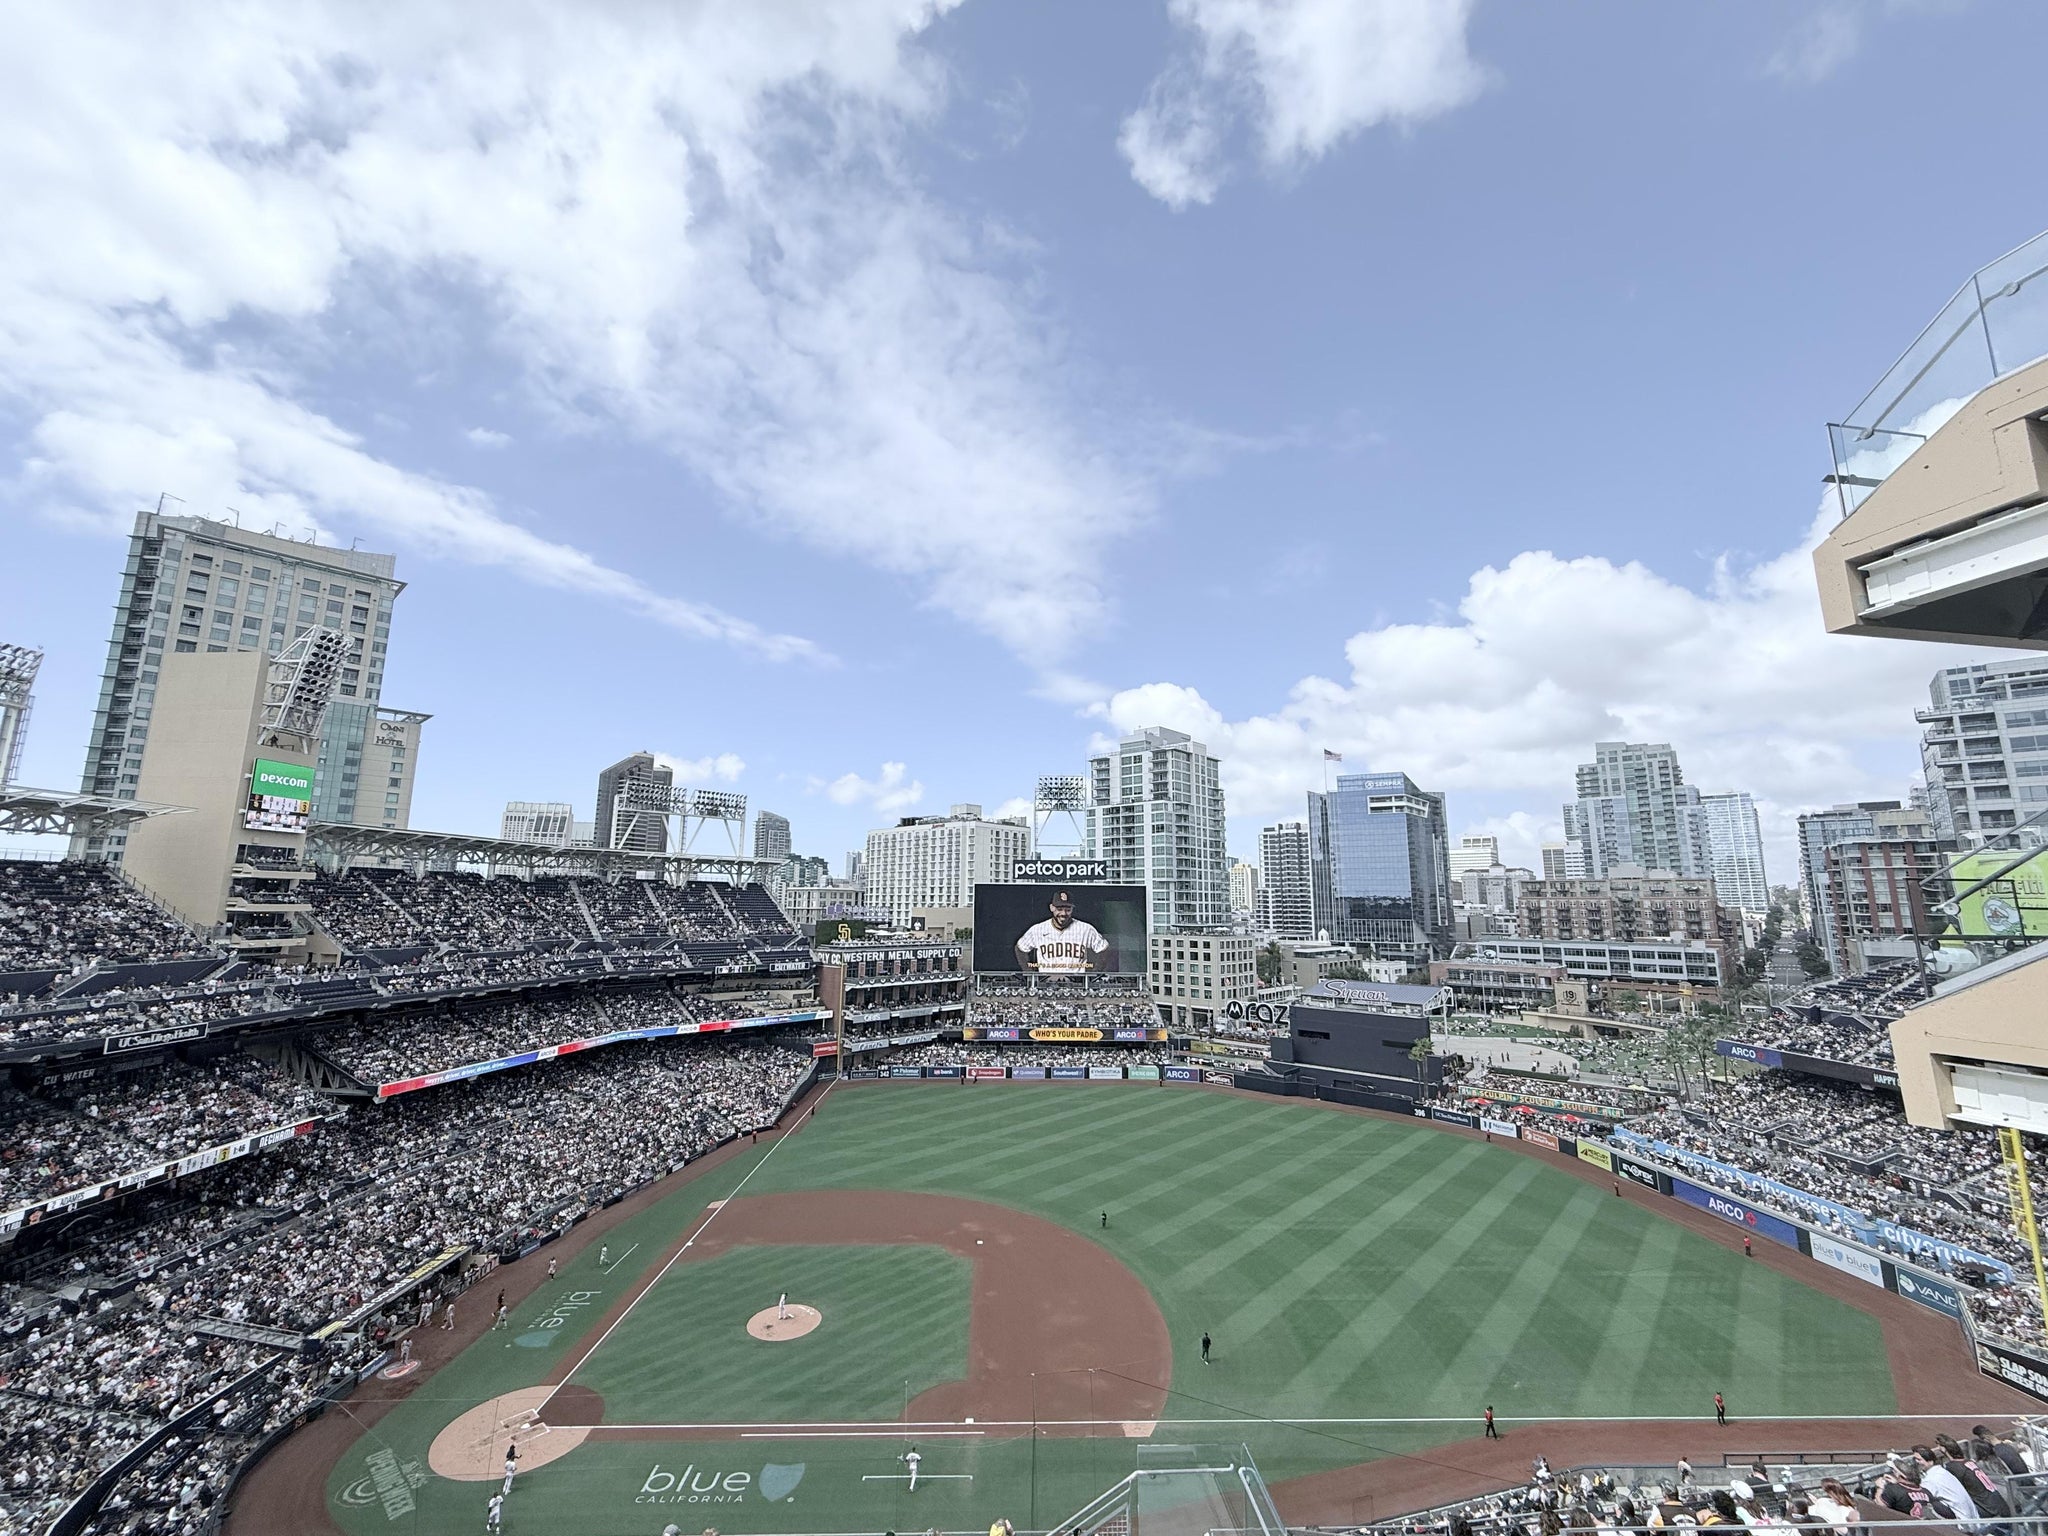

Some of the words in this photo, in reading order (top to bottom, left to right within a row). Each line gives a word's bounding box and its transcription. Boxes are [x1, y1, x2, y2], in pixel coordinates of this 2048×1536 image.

[1014, 861, 1064, 879] petco
[1066, 862, 1105, 879] park
[843, 951, 885, 963] WESTERN
[888, 950, 915, 961] METAL
[917, 949, 946, 959] SUPPLY
[949, 948, 962, 957] CO.
[1039, 942, 1086, 959] PADRES
[1324, 979, 1388, 1003] Sycuan
[1034, 1030, 1057, 1038] WHO'S
[1058, 1030, 1076, 1038] YOUR
[1076, 1031, 1098, 1039] PADRE
[1116, 1031, 1136, 1039] ARCO
[1731, 1046, 1756, 1059] ARCO
[880, 1070, 890, 1078] 342
[1166, 1070, 1190, 1079] ARCO
[1873, 1072, 1897, 1086] HAPPY
[1479, 1090, 1512, 1102] SCULPIN
[1519, 1096, 1555, 1108] SCULPIN
[1414, 1108, 1426, 1118] 396
[1561, 1102, 1598, 1114] SCULPIN
[1708, 1197, 1744, 1221] ARCO
[1813, 1241, 1834, 1257] blue
[1846, 1254, 1870, 1272] blue
[540, 1291, 602, 1328] blue
[1999, 1356, 2027, 1376] SLAP
[2001, 1368, 2036, 1392] CHEESE
[640, 1463, 751, 1493] blue
[634, 1494, 744, 1504] CALIFORNIA
